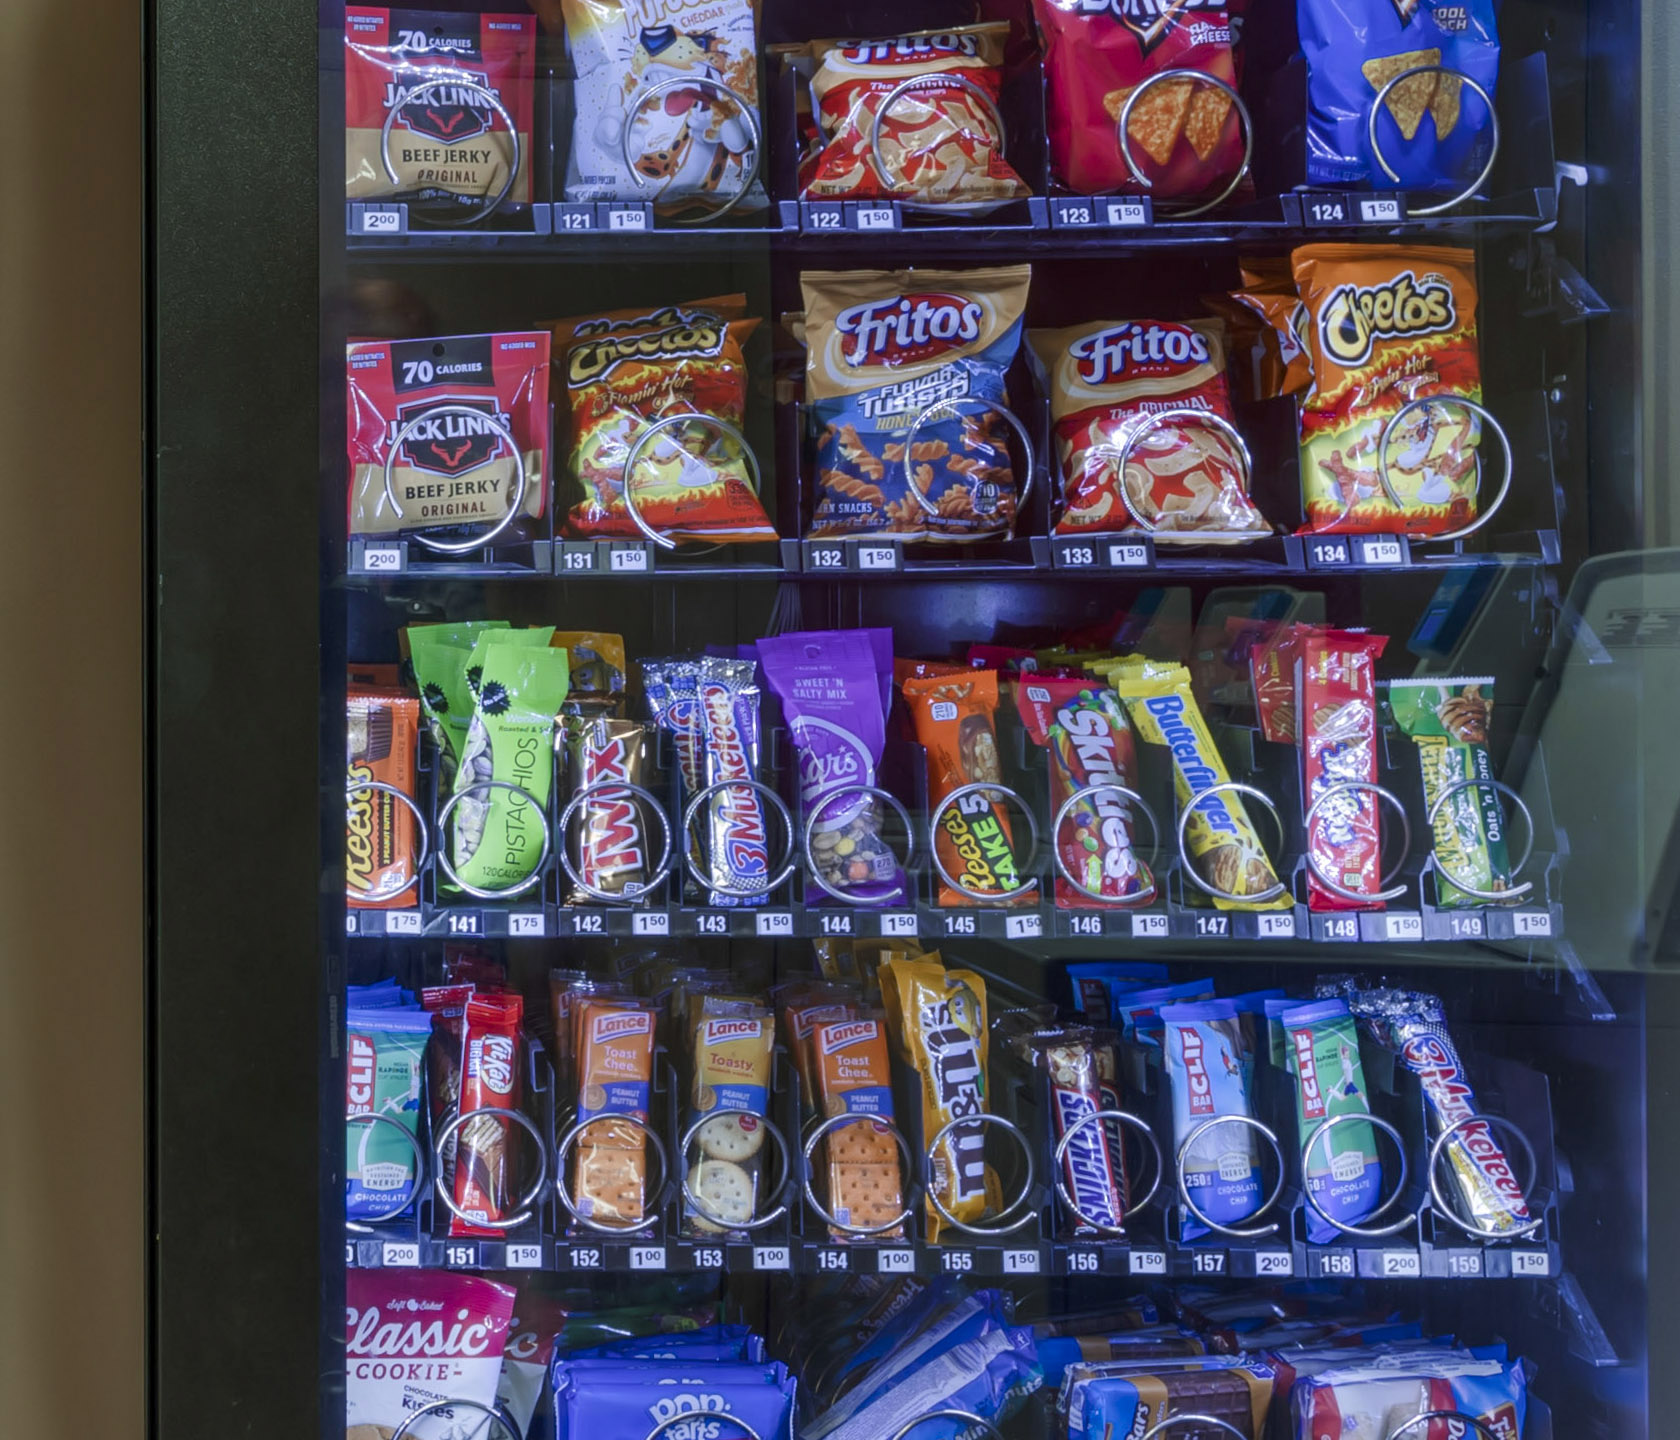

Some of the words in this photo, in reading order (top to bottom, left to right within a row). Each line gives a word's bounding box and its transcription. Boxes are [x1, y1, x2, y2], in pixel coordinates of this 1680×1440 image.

[399, 31, 427, 50] 70
[429, 38, 472, 49] CALORIES
[402, 149, 439, 165] BEEF
[443, 149, 490, 165] JERKY
[810, 212, 840, 228] 122
[1059, 208, 1090, 223] 123
[1313, 204, 1343, 220] 124
[563, 214, 591, 229] 121
[1319, 274, 1455, 364] Cheetos
[836, 295, 982, 368] Fritos
[1070, 322, 1208, 385] Fritos
[403, 362, 433, 384] 70
[436, 362, 482, 375] CALORIES
[405, 483, 445, 500] BEEF
[449, 478, 500, 497] JERKY
[421, 501, 486, 516] ORIGINAL
[564, 553, 593, 568] 131
[812, 550, 841, 566] 132
[1062, 548, 1092, 563] 133
[1314, 545, 1345, 561] 134
[795, 677, 829, 688] SWEET
[793, 688, 824, 699] SALTY
[827, 689, 846, 700] MIX
[506, 738, 538, 865] PISTACHIOS
[582, 739, 642, 893] TWIX
[449, 917, 476, 932] 141
[573, 917, 601, 932] 142
[697, 917, 726, 933] 143
[821, 917, 850, 932] 144
[945, 917, 974, 932] 145
[1071, 917, 1101, 932] 146
[1197, 918, 1227, 934] 147
[1324, 921, 1355, 936] 148
[1451, 919, 1481, 934] 149
[596, 1015, 647, 1035] Lance
[825, 1021, 874, 1043] Lance
[836, 1055, 870, 1067] Toast
[1182, 1030, 1210, 1095] CLIF
[1296, 1032, 1321, 1098] CLIF
[851, 1095, 879, 1104] PEANUT
[852, 1103, 878, 1112] BUTTER
[1192, 1096, 1212, 1107] BAR
[1060, 1093, 1115, 1229] SNICKERS
[447, 1248, 474, 1264] 151
[570, 1250, 599, 1265] 152
[694, 1250, 722, 1266] 153
[818, 1253, 847, 1268] 154
[942, 1254, 972, 1270] 155
[1068, 1254, 1097, 1270] 156
[1194, 1255, 1224, 1271] 157
[1321, 1256, 1351, 1273] 158
[1449, 1256, 1479, 1273] 159
[356, 1363, 448, 1380] COOKIE
